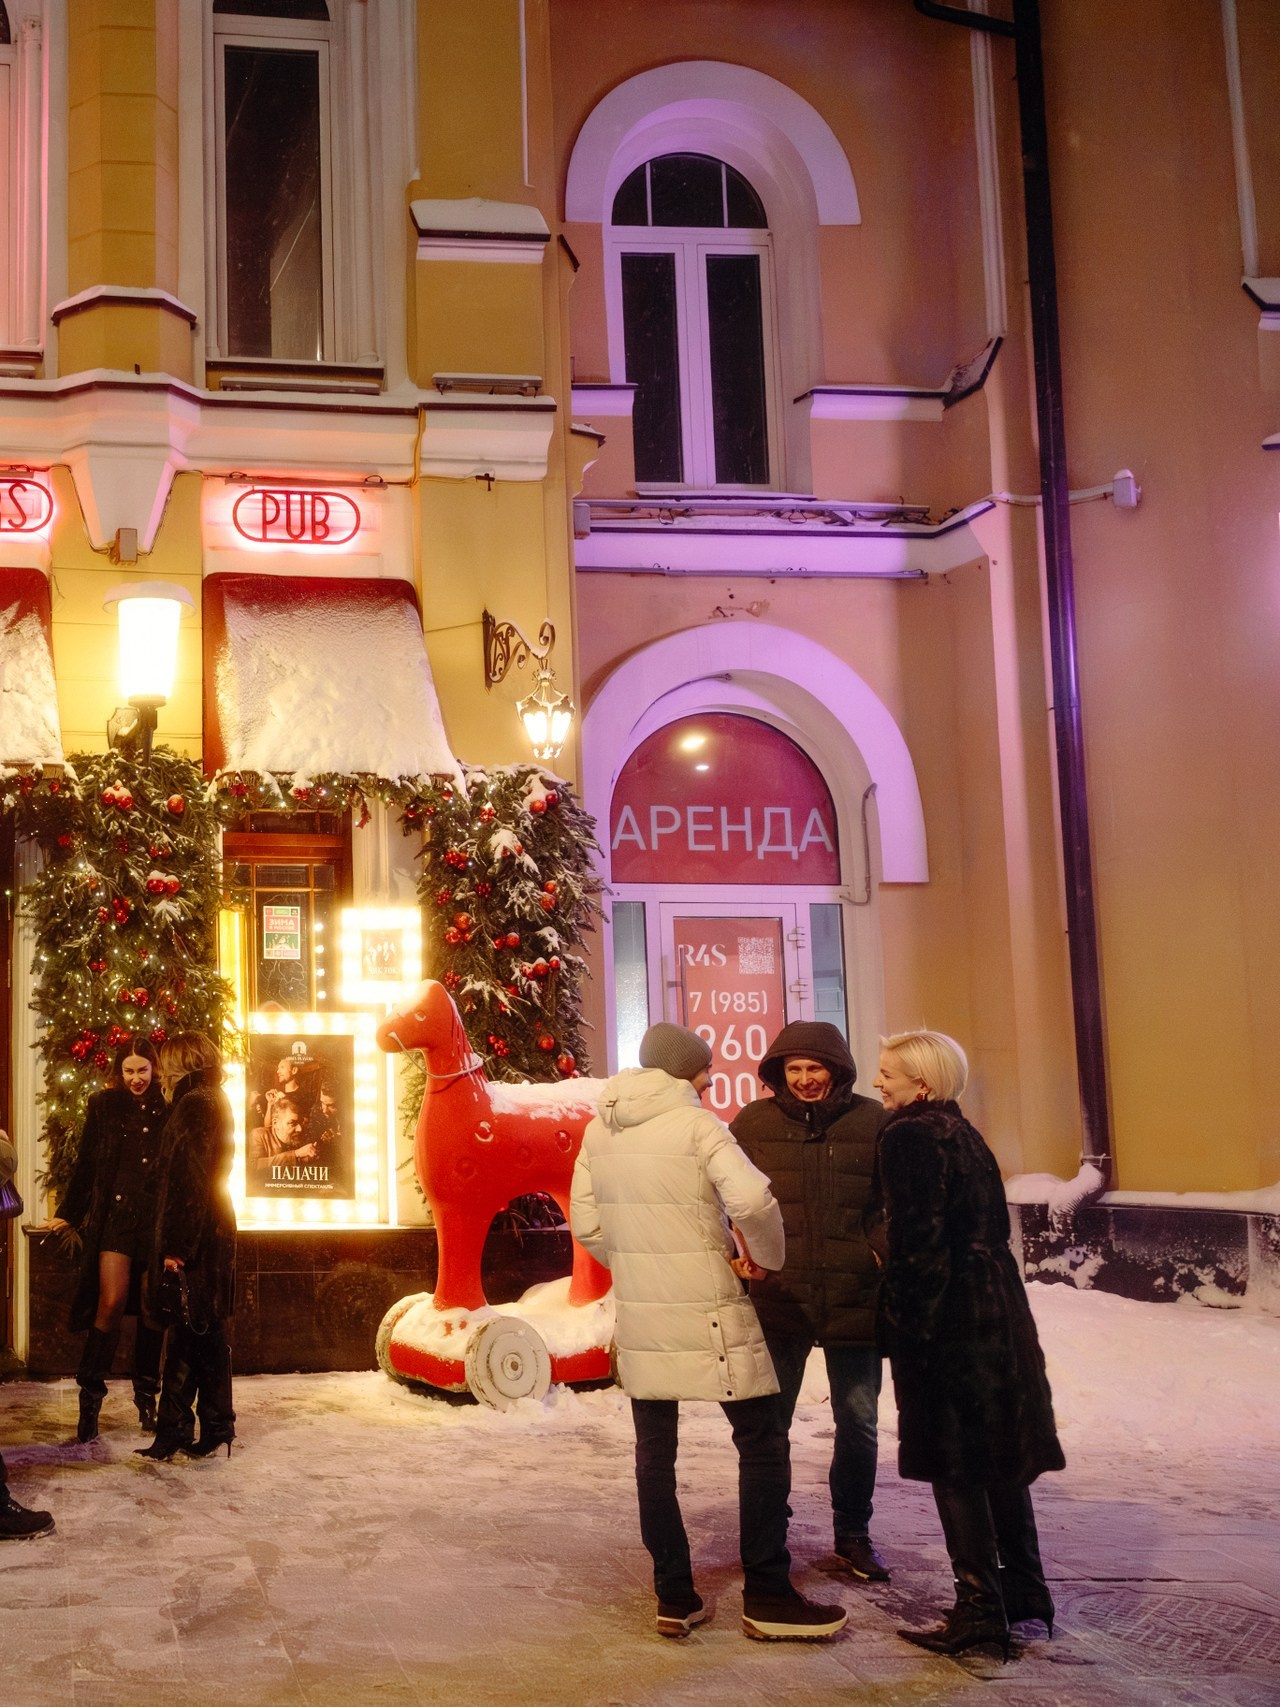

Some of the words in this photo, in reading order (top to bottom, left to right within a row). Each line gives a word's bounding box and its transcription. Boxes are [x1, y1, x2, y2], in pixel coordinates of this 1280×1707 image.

[261, 491, 330, 541] PUB
[611, 804, 834, 860] АРЕНДА
[678, 943, 728, 968] R4S
[710, 989, 768, 1015] (985)
[271, 1165, 329, 1181] ПАЛАЧИ
